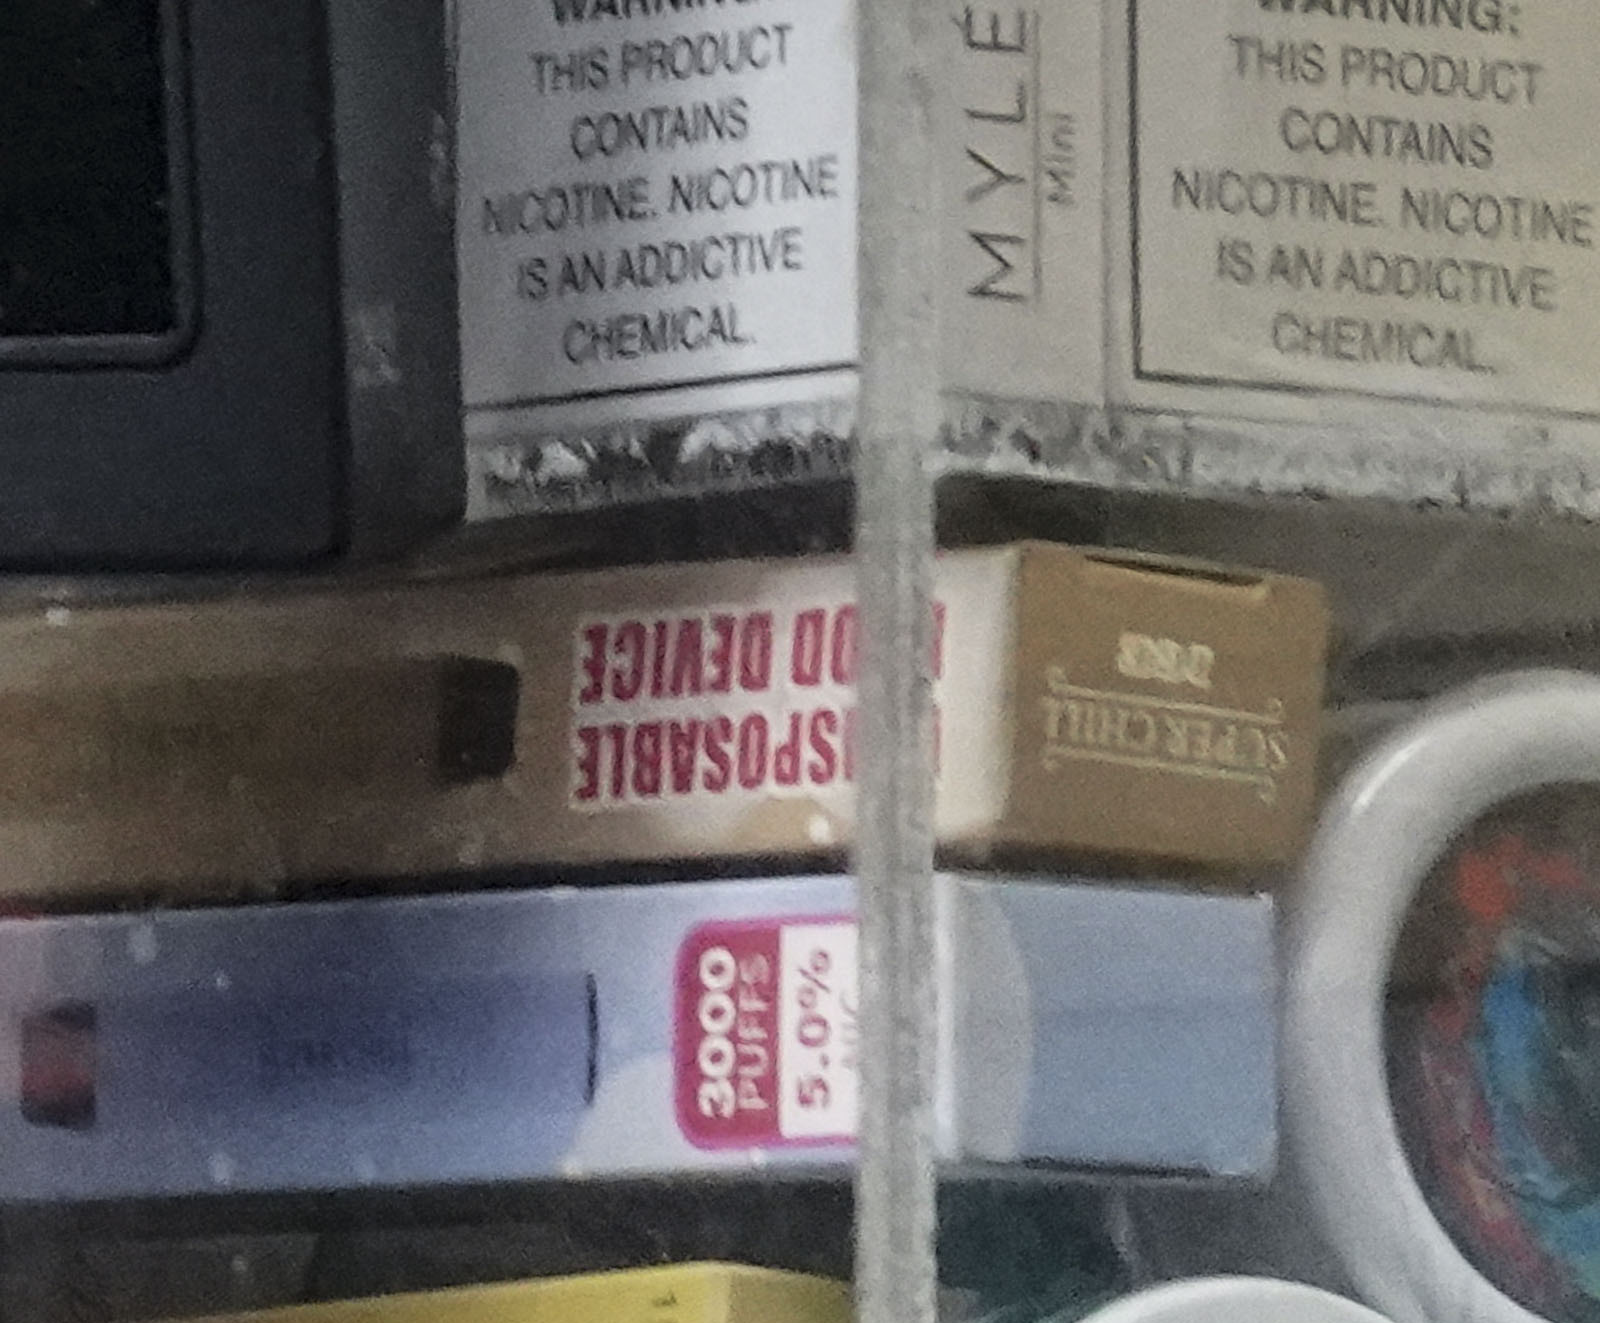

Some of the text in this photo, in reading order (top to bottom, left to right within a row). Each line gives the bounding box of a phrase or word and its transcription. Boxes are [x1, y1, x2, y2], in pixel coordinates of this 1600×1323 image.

[528, 22, 793, 94] THIS PRODUCT
[1228, 31, 1543, 103] THIS PRODUCT
[569, 97, 749, 161] CONTAINS
[1280, 106, 1494, 169] CONTAINS
[669, 153, 840, 216] NICOTINE
[1400, 183, 1595, 249] NICOTINE
[516, 225, 804, 301] IS AN ADDICTIVE
[1215, 239, 1557, 314] IS AN ADDICTIVE
[580, 603, 947, 705] OD DEVICE
[698, 945, 736, 1120] 3000
[738, 949, 771, 1110] PUFFS
[797, 949, 833, 1111] 5.0%
